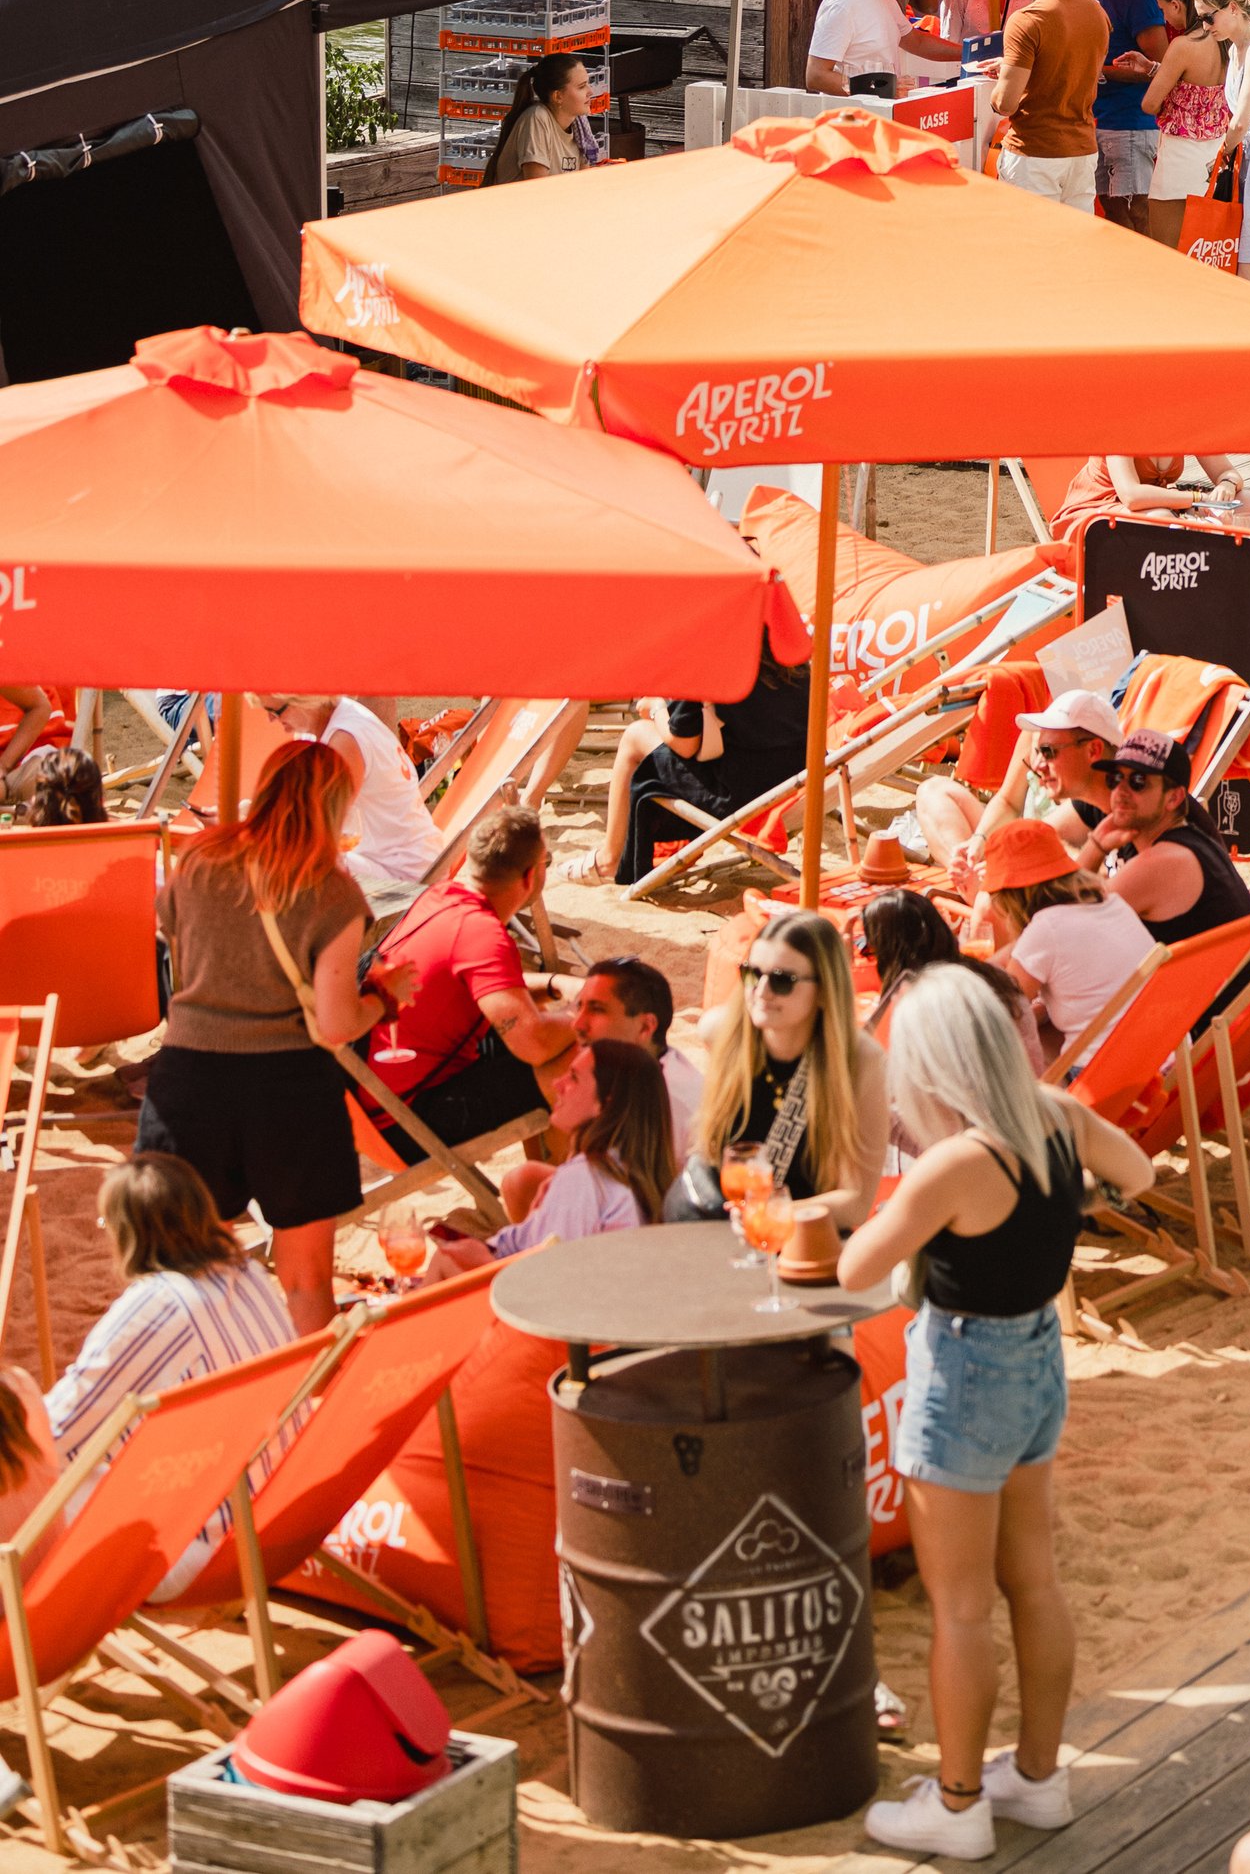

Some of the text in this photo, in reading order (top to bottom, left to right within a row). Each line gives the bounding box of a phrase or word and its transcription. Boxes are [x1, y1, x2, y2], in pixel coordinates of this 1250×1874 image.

[920, 111, 949, 130] KASSE
[1186, 237, 1240, 258] APEROL
[676, 361, 833, 437] APEROL
[1140, 551, 1210, 579] APEROL
[830, 603, 930, 672] EROL
[681, 1578, 844, 1649] SALITOS
